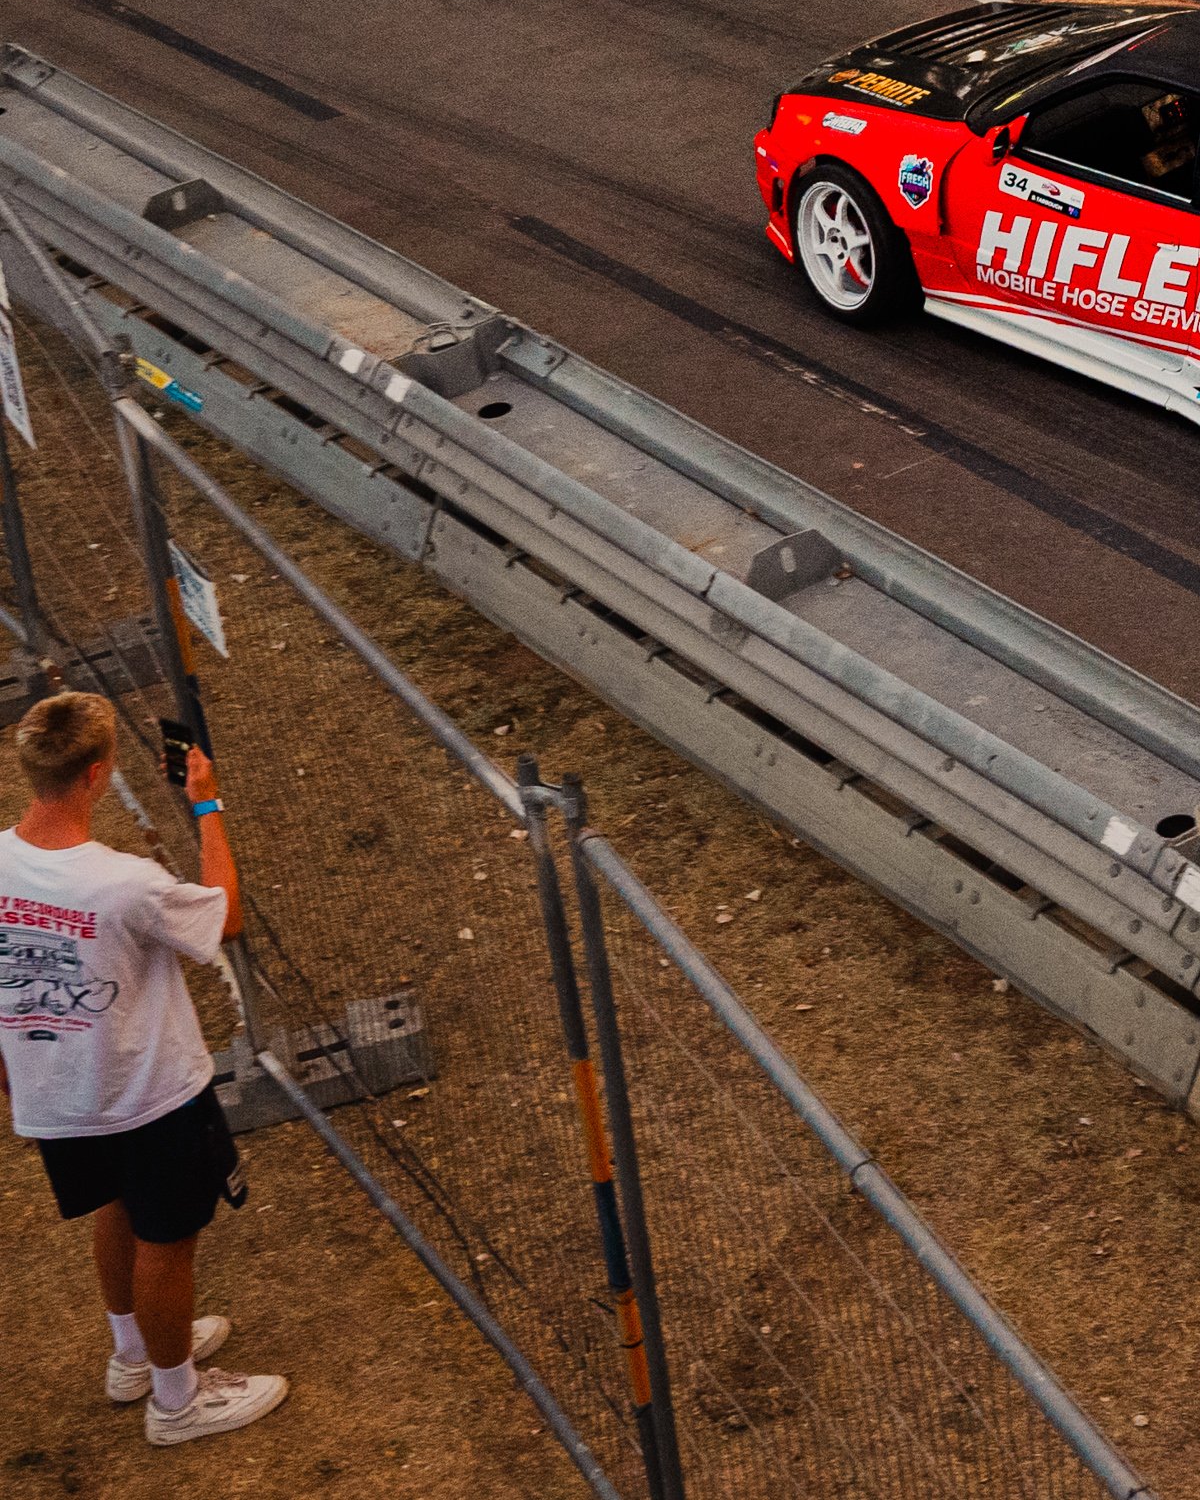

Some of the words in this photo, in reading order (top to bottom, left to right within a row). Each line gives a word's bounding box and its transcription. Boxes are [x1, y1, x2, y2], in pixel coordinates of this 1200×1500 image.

[850, 72, 931, 105] PENRITE
[901, 171, 929, 190] FRESH
[1004, 172, 1029, 192] 34
[976, 265, 1057, 301] MOBILE
[1062, 285, 1128, 317] HOSE
[0, 910, 97, 939] SSETTE
